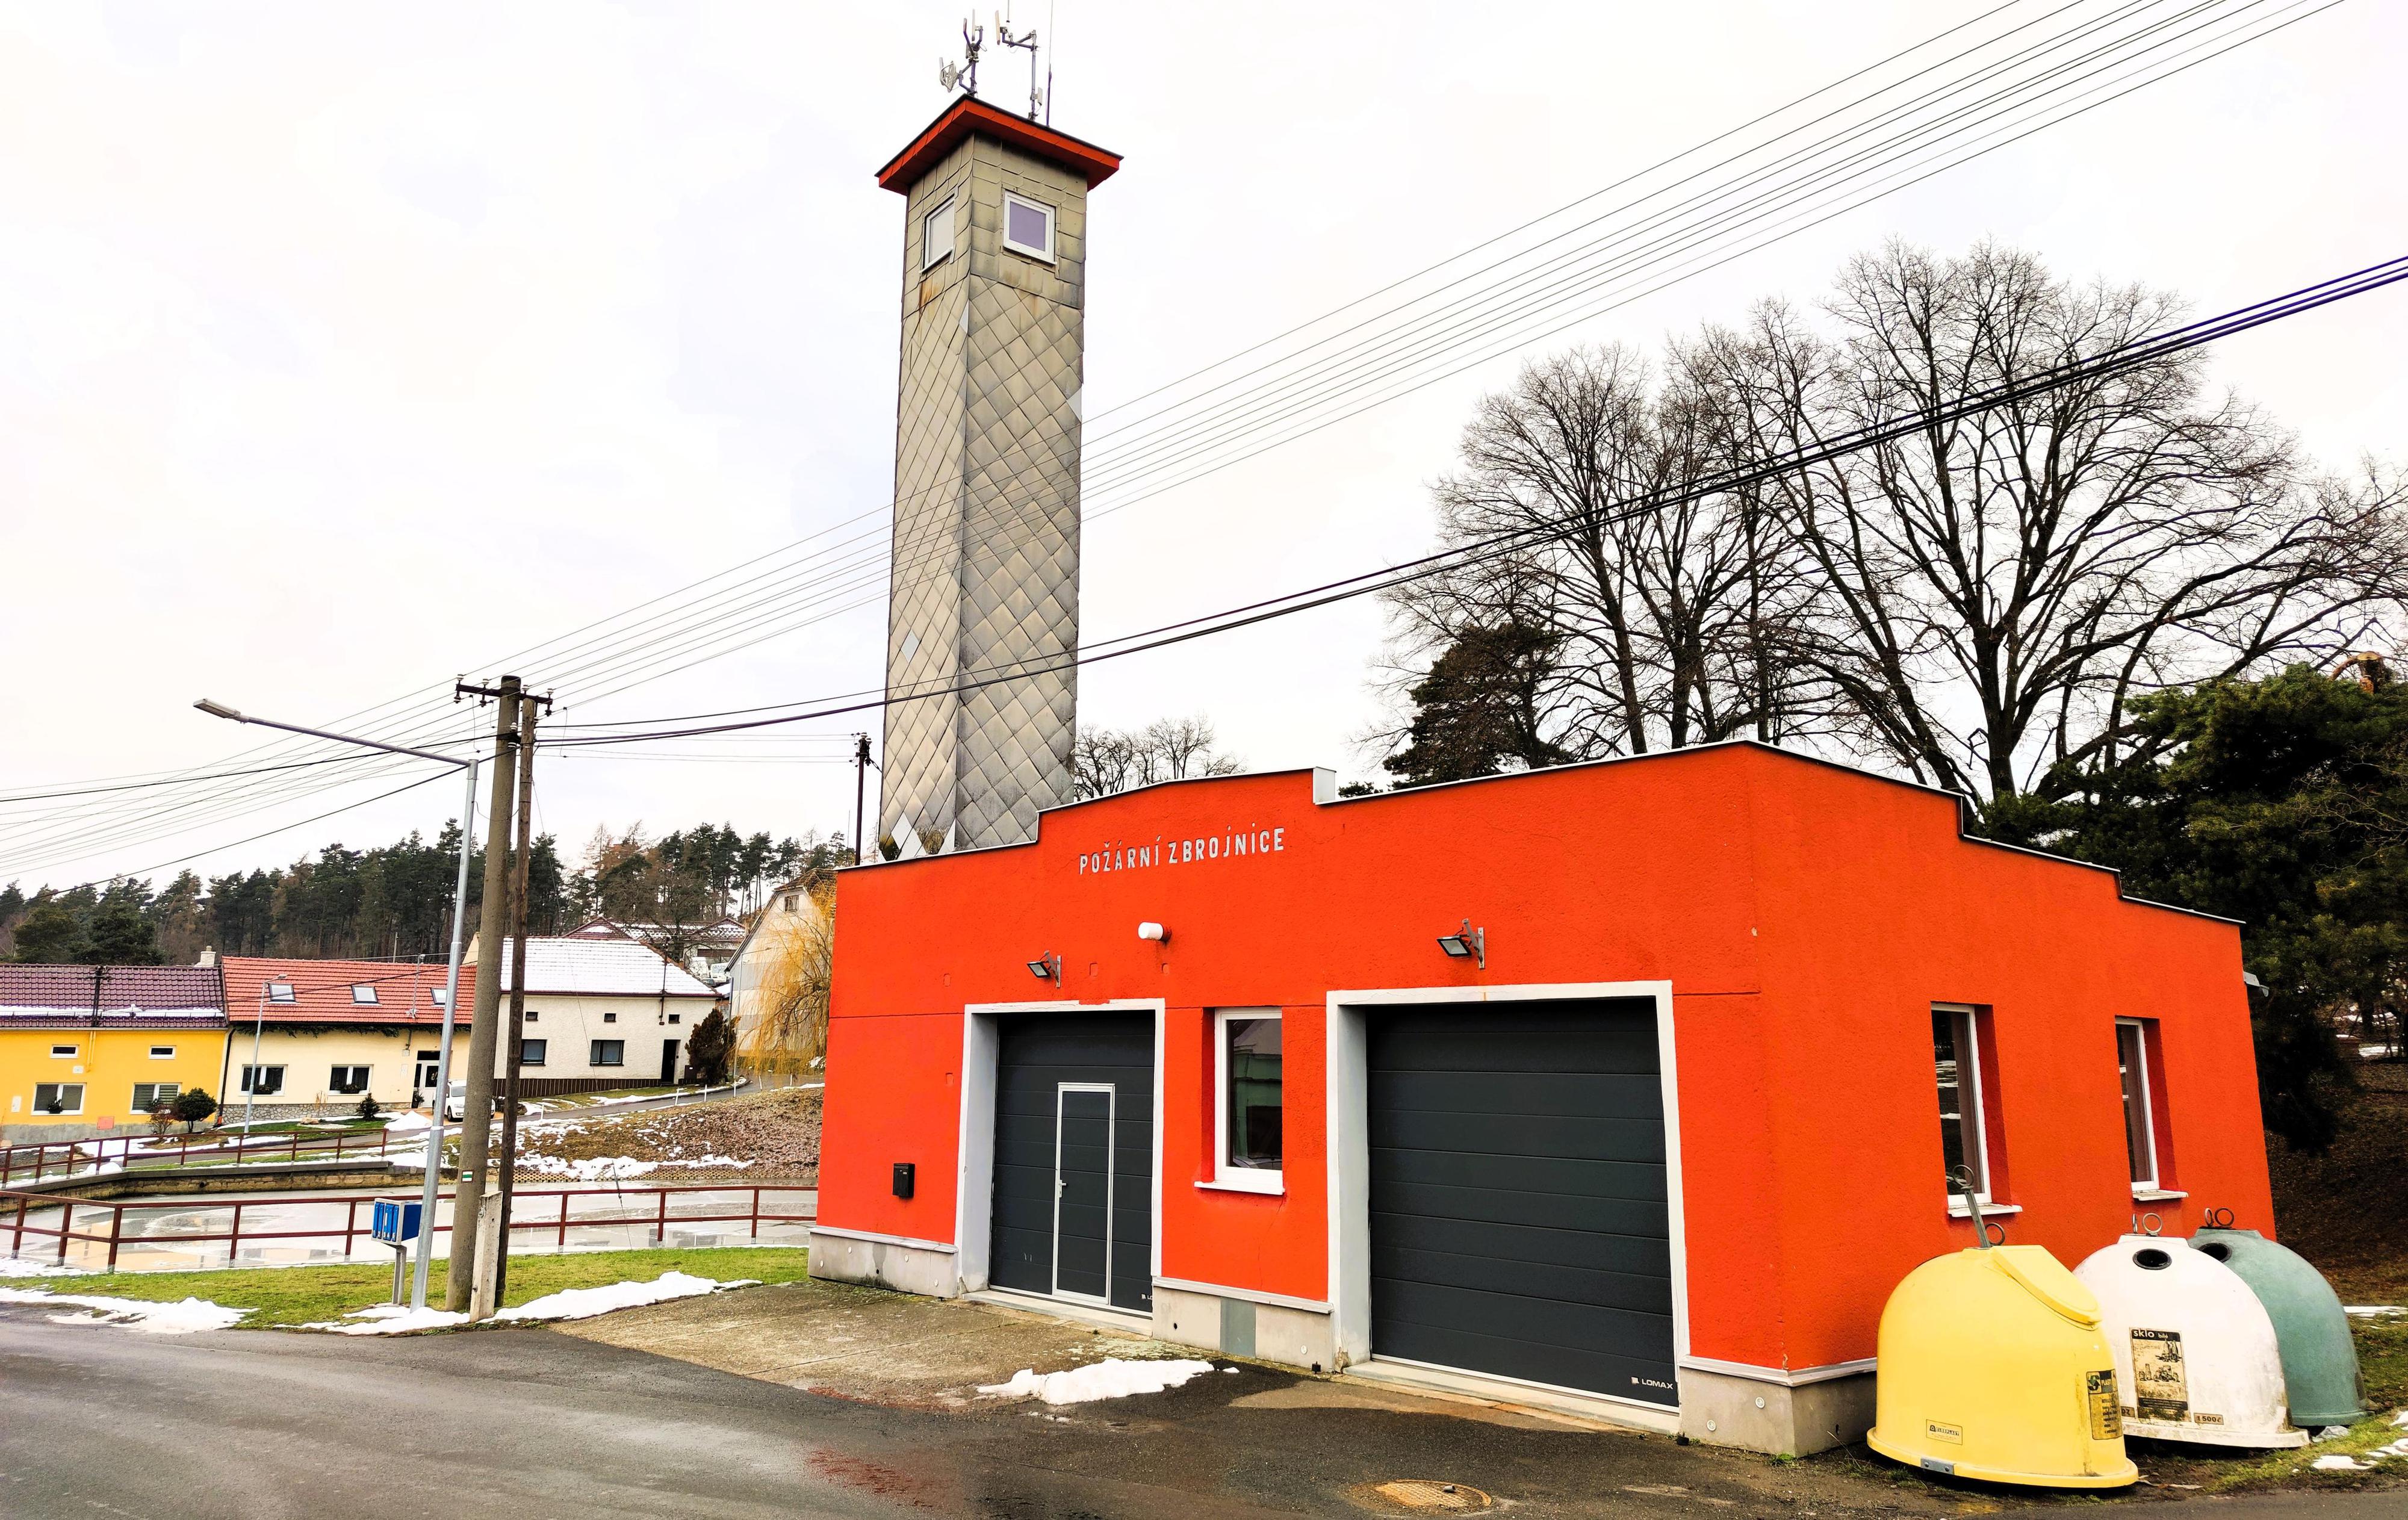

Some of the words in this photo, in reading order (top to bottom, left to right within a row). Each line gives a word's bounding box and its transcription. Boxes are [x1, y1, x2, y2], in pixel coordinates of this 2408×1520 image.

[1079, 835, 1161, 875] POŽÁRNÍ
[1168, 822, 1285, 864] ZBROJNICE
[2133, 1329, 2155, 1338] sklo
[1642, 1378, 1674, 1389] LOMAX
